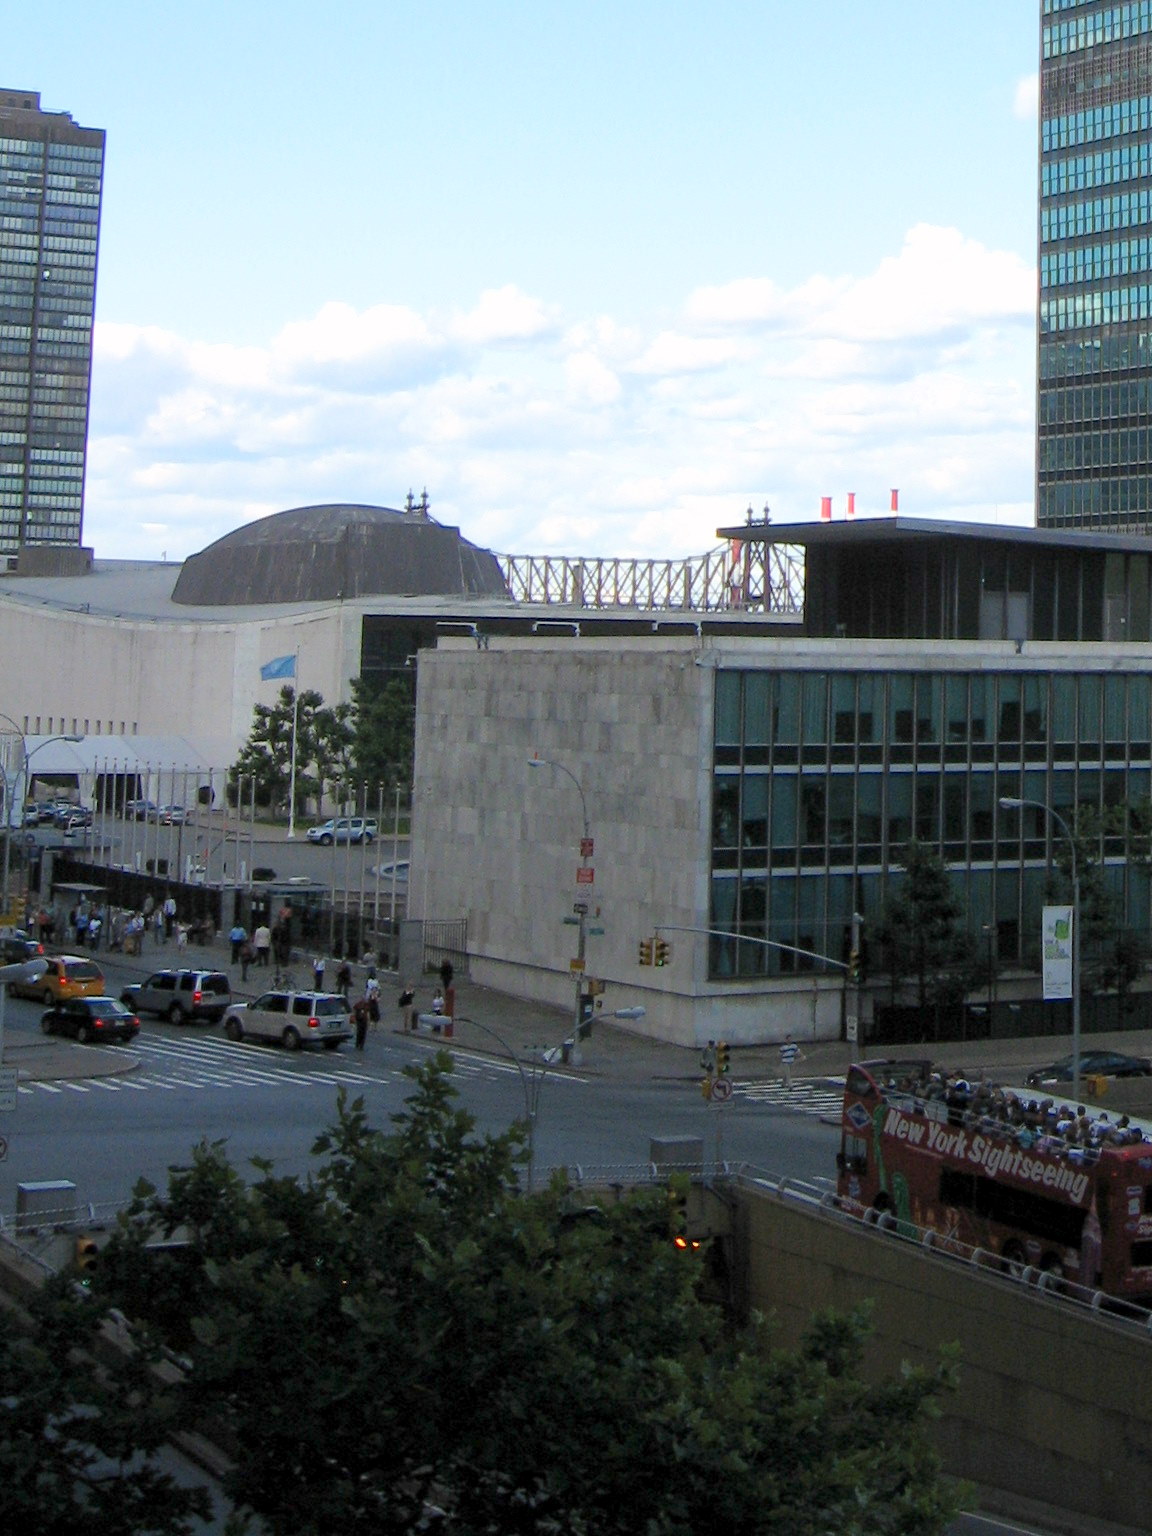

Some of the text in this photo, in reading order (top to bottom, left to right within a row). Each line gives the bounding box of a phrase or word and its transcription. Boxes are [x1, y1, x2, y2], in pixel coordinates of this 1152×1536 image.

[883, 1108, 1090, 1204] New York Sightseeing
